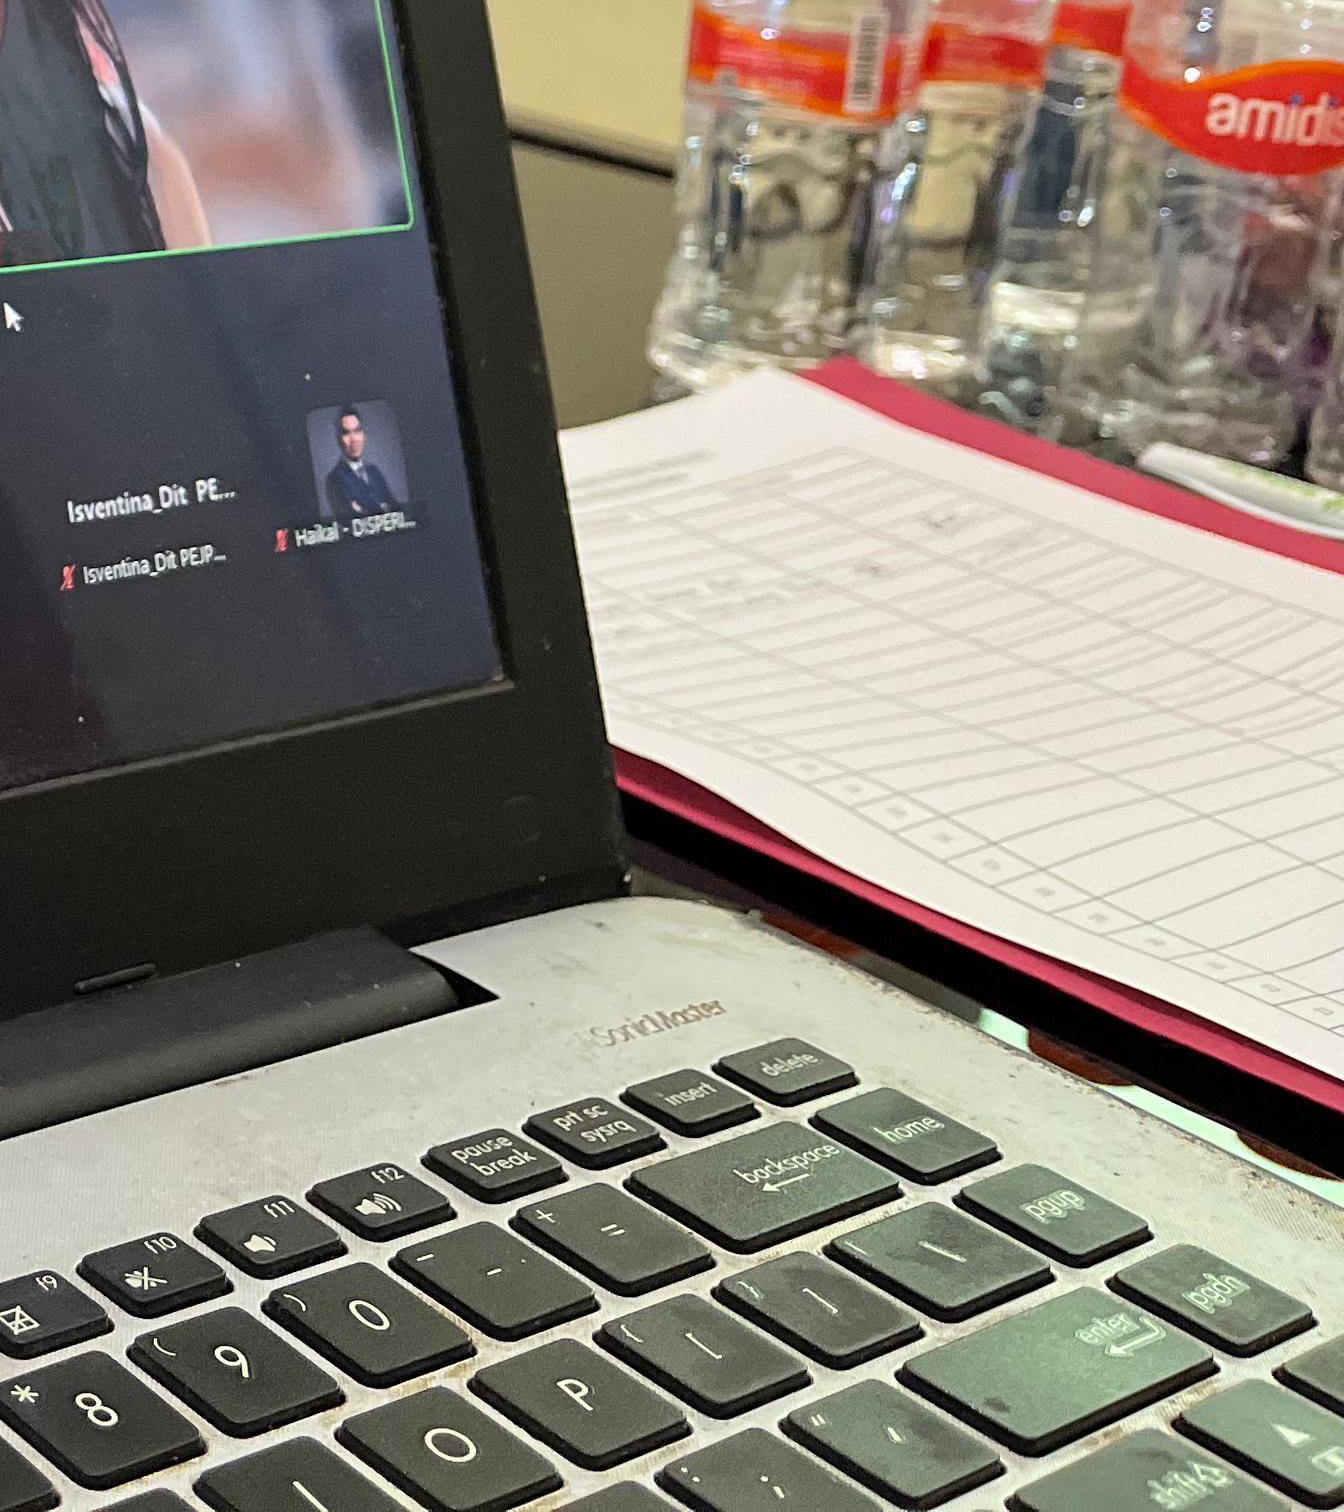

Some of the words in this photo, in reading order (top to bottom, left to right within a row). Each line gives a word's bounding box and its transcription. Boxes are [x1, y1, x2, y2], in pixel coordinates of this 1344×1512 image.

[67, 483, 189, 524] Isventina_Dit
[82, 550, 179, 584] Isventina_Dit
[761, 1051, 820, 1076] delete
[662, 1080, 717, 1105] insert
[552, 1109, 581, 1131] prt
[582, 1101, 610, 1119] sc
[579, 1116, 637, 1144] sysrq
[873, 1114, 940, 1143] home
[450, 1133, 514, 1162] pause
[468, 1145, 538, 1177] break
[732, 1141, 843, 1185] backspace
[370, 1165, 405, 1185] f12
[263, 1199, 296, 1219] f11
[1024, 1188, 1084, 1222] pgup
[143, 1234, 179, 1256] f10
[34, 1273, 58, 1292] f9
[1187, 1272, 1247, 1313] pgdn
[1074, 1312, 1139, 1345] enter
[213, 1345, 250, 1379] 9
[74, 1392, 119, 1427] 8
[556, 1377, 594, 1412] P
[423, 1427, 477, 1463] O
